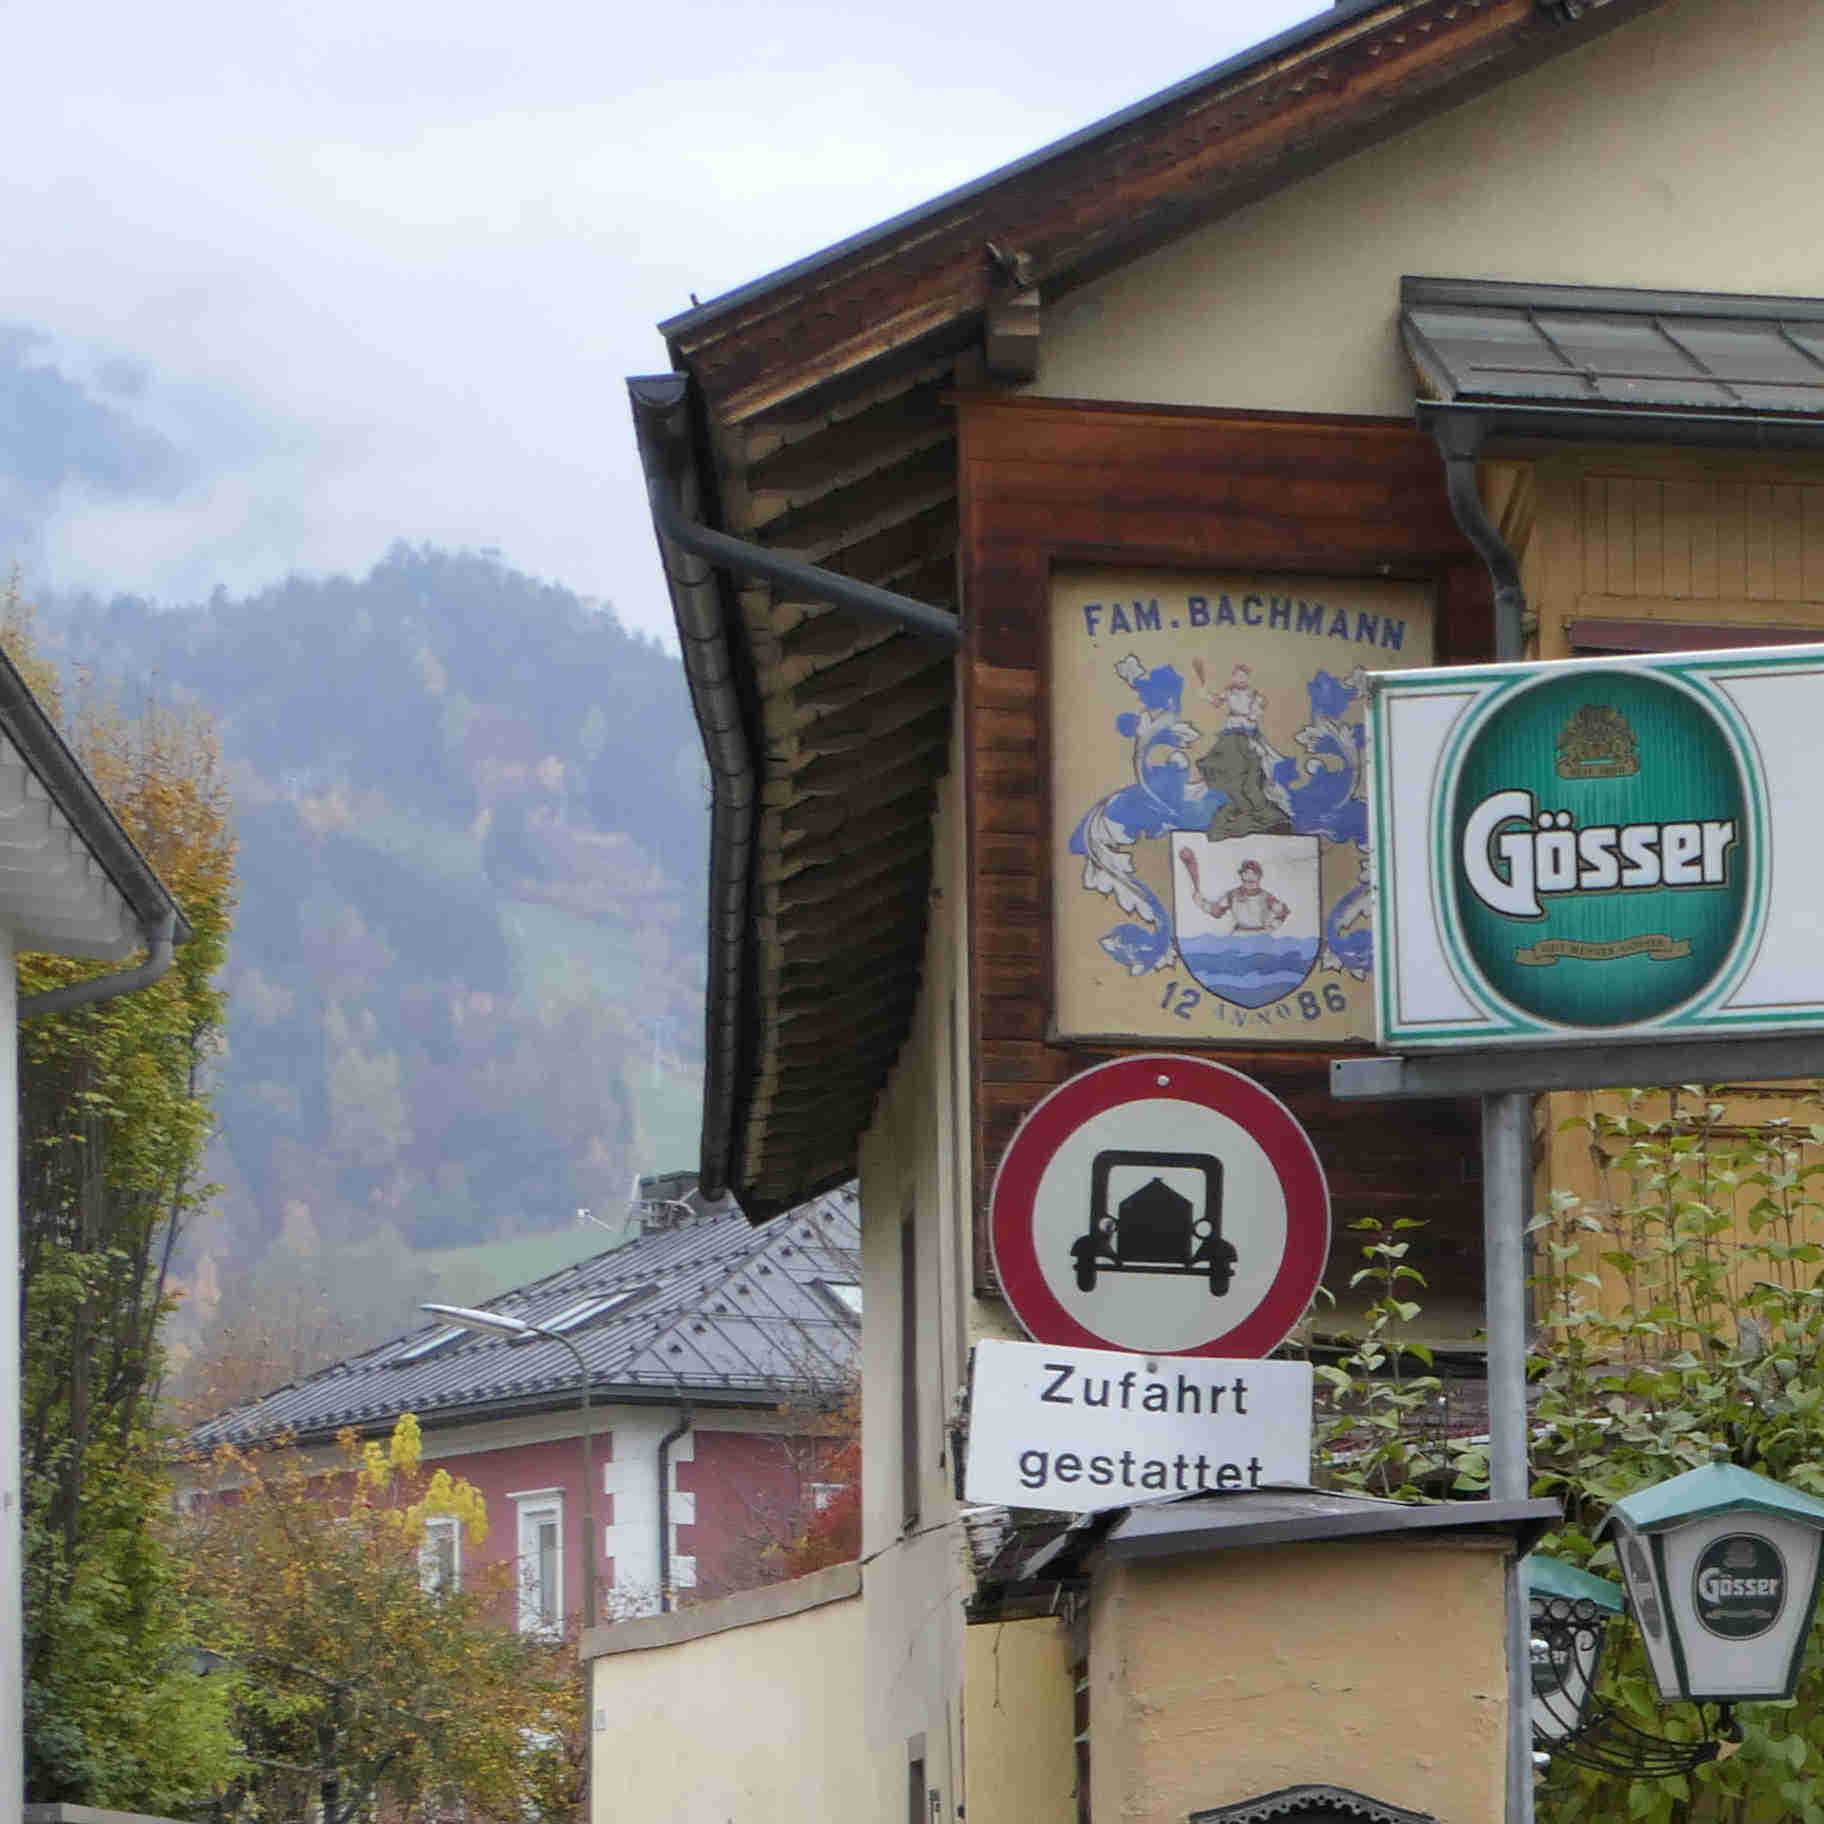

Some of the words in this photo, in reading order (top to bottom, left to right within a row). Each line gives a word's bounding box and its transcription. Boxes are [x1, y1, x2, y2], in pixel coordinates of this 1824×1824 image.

[1083, 598, 1180, 636] FAM.
[1187, 594, 1406, 650] BACHMANN
[1463, 788, 1738, 920] Gösser
[1160, 981, 1200, 1020] 12
[1298, 983, 1347, 1021] 86
[1040, 1363, 1248, 1415] Zufahrt
[1018, 1448, 1263, 1489] gestattet
[1699, 1567, 1779, 1604] Gösser
